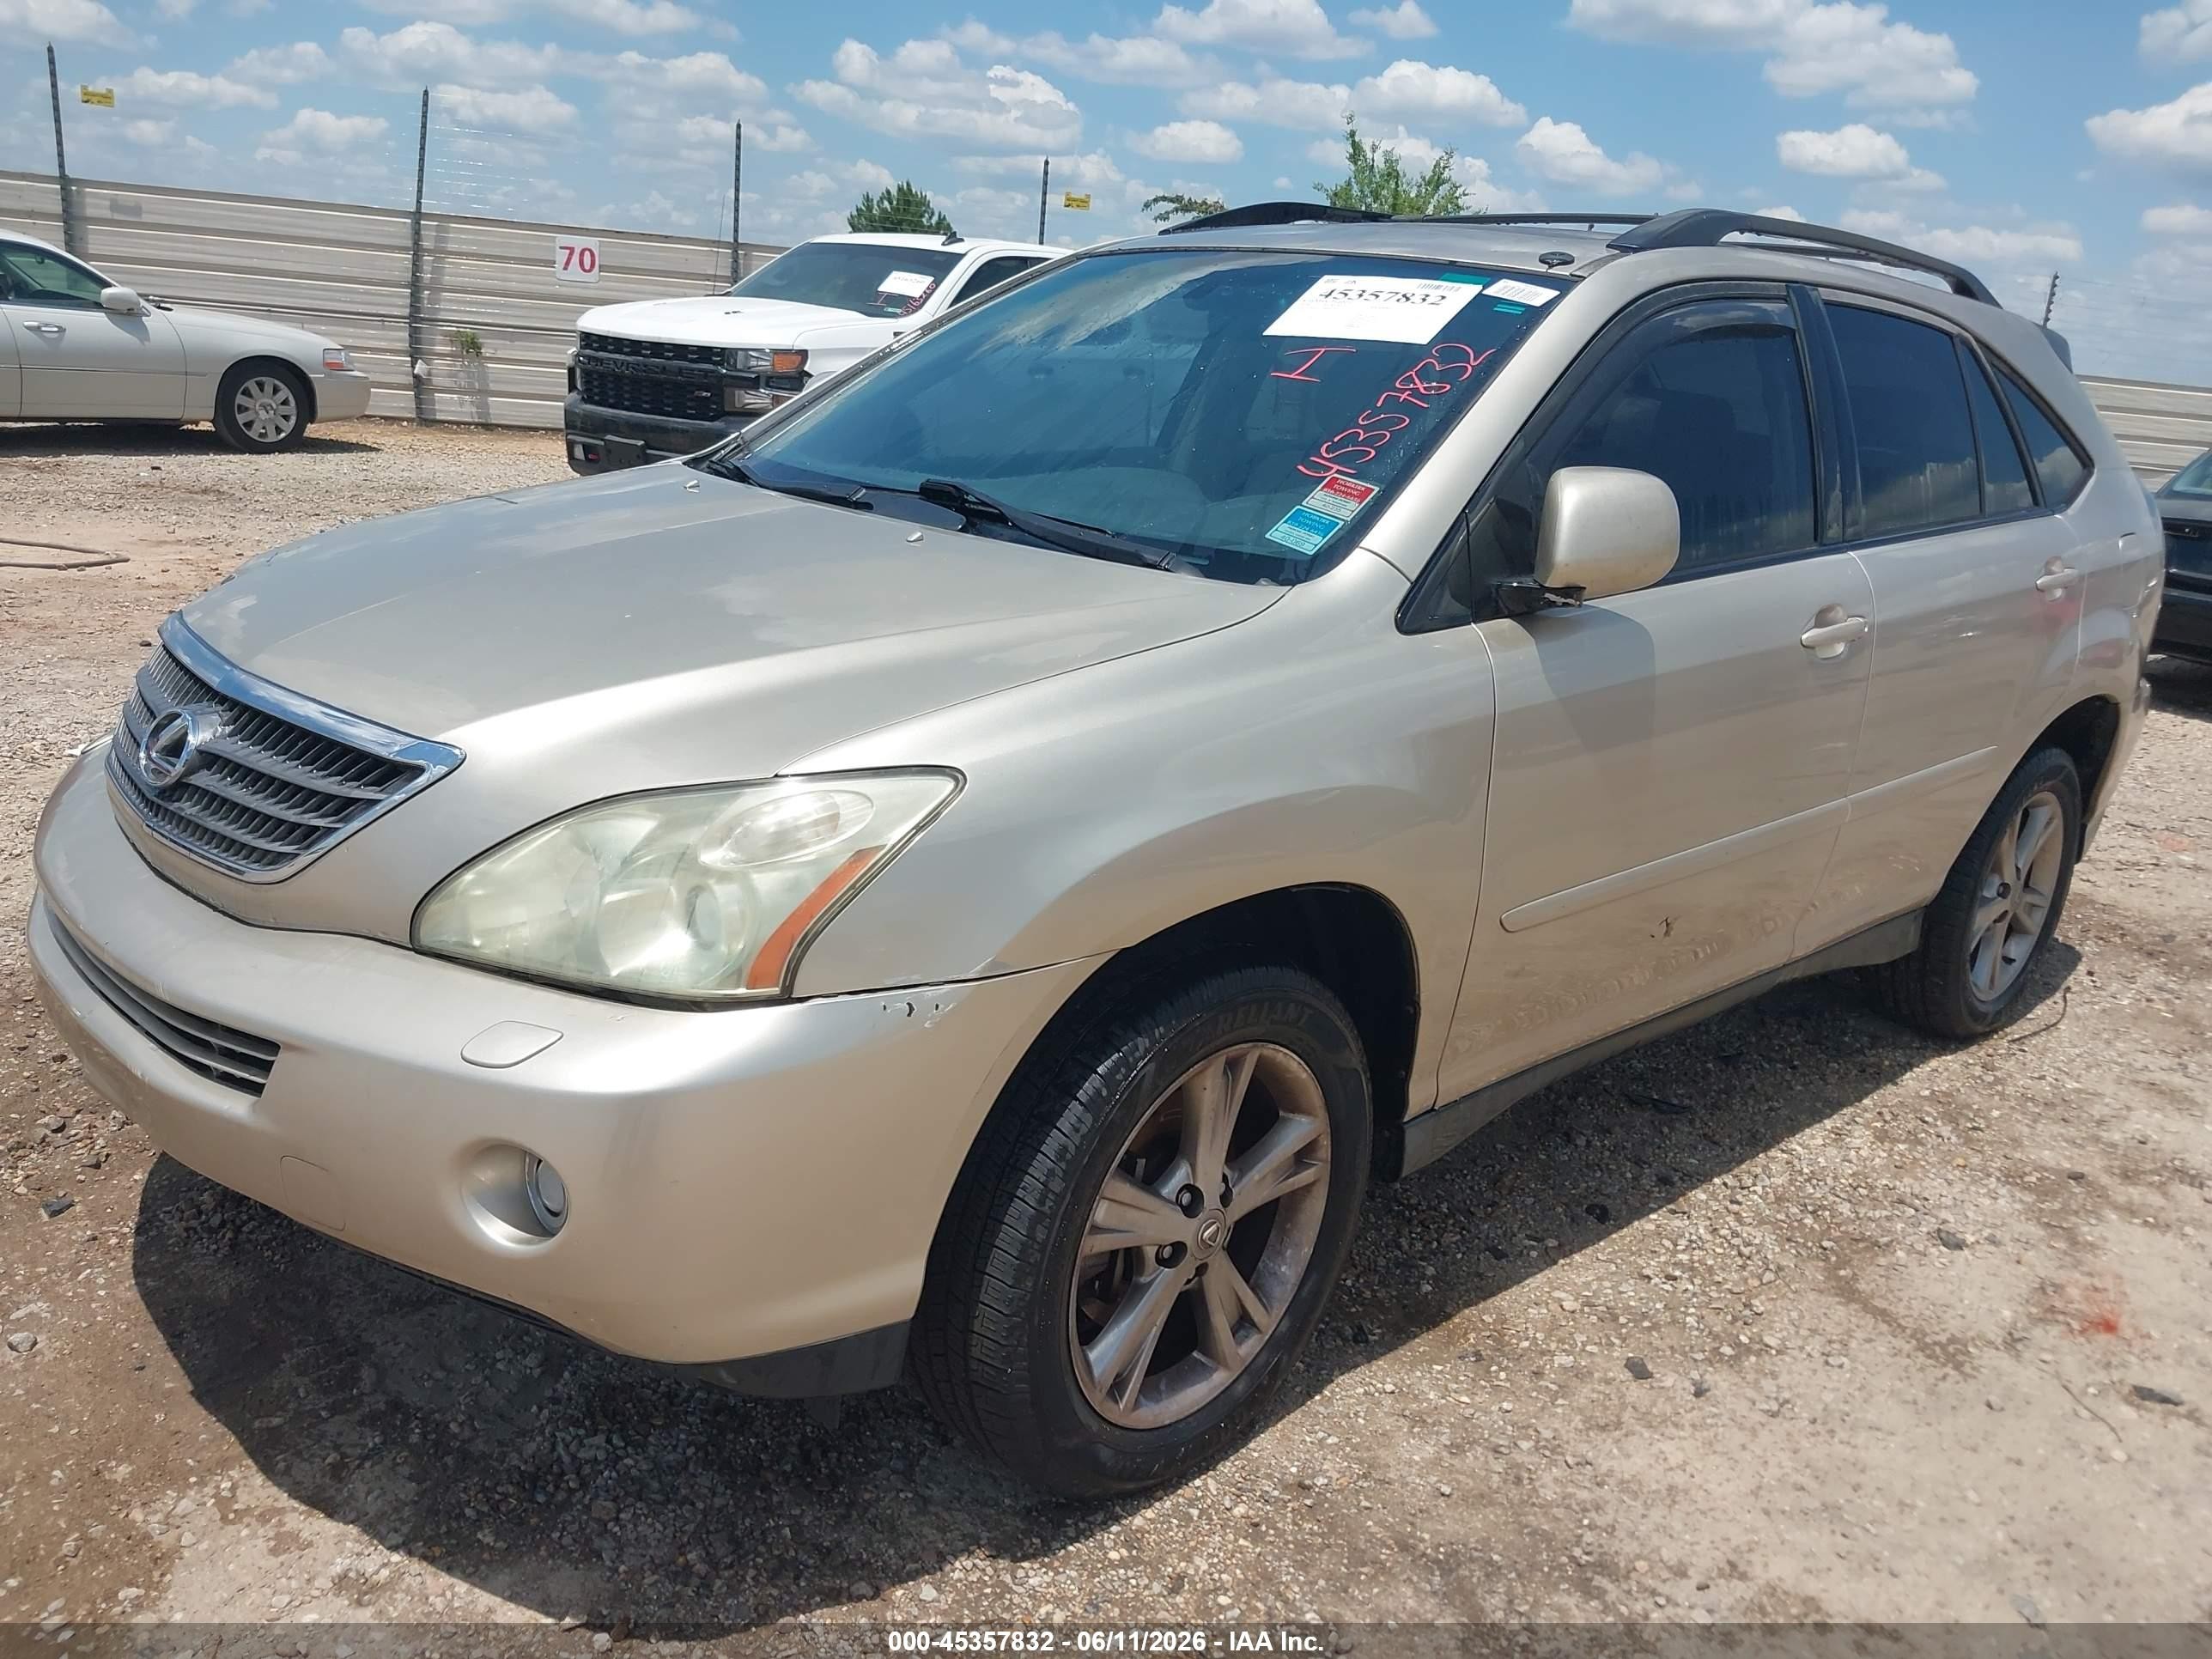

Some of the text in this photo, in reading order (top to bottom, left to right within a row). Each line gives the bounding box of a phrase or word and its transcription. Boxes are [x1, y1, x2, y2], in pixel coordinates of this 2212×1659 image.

[558, 246, 597, 274] 70
[1318, 289, 1448, 307] 45357832
[1296, 343, 1498, 477] 45357832
[1333, 483, 1361, 496] TOWING
